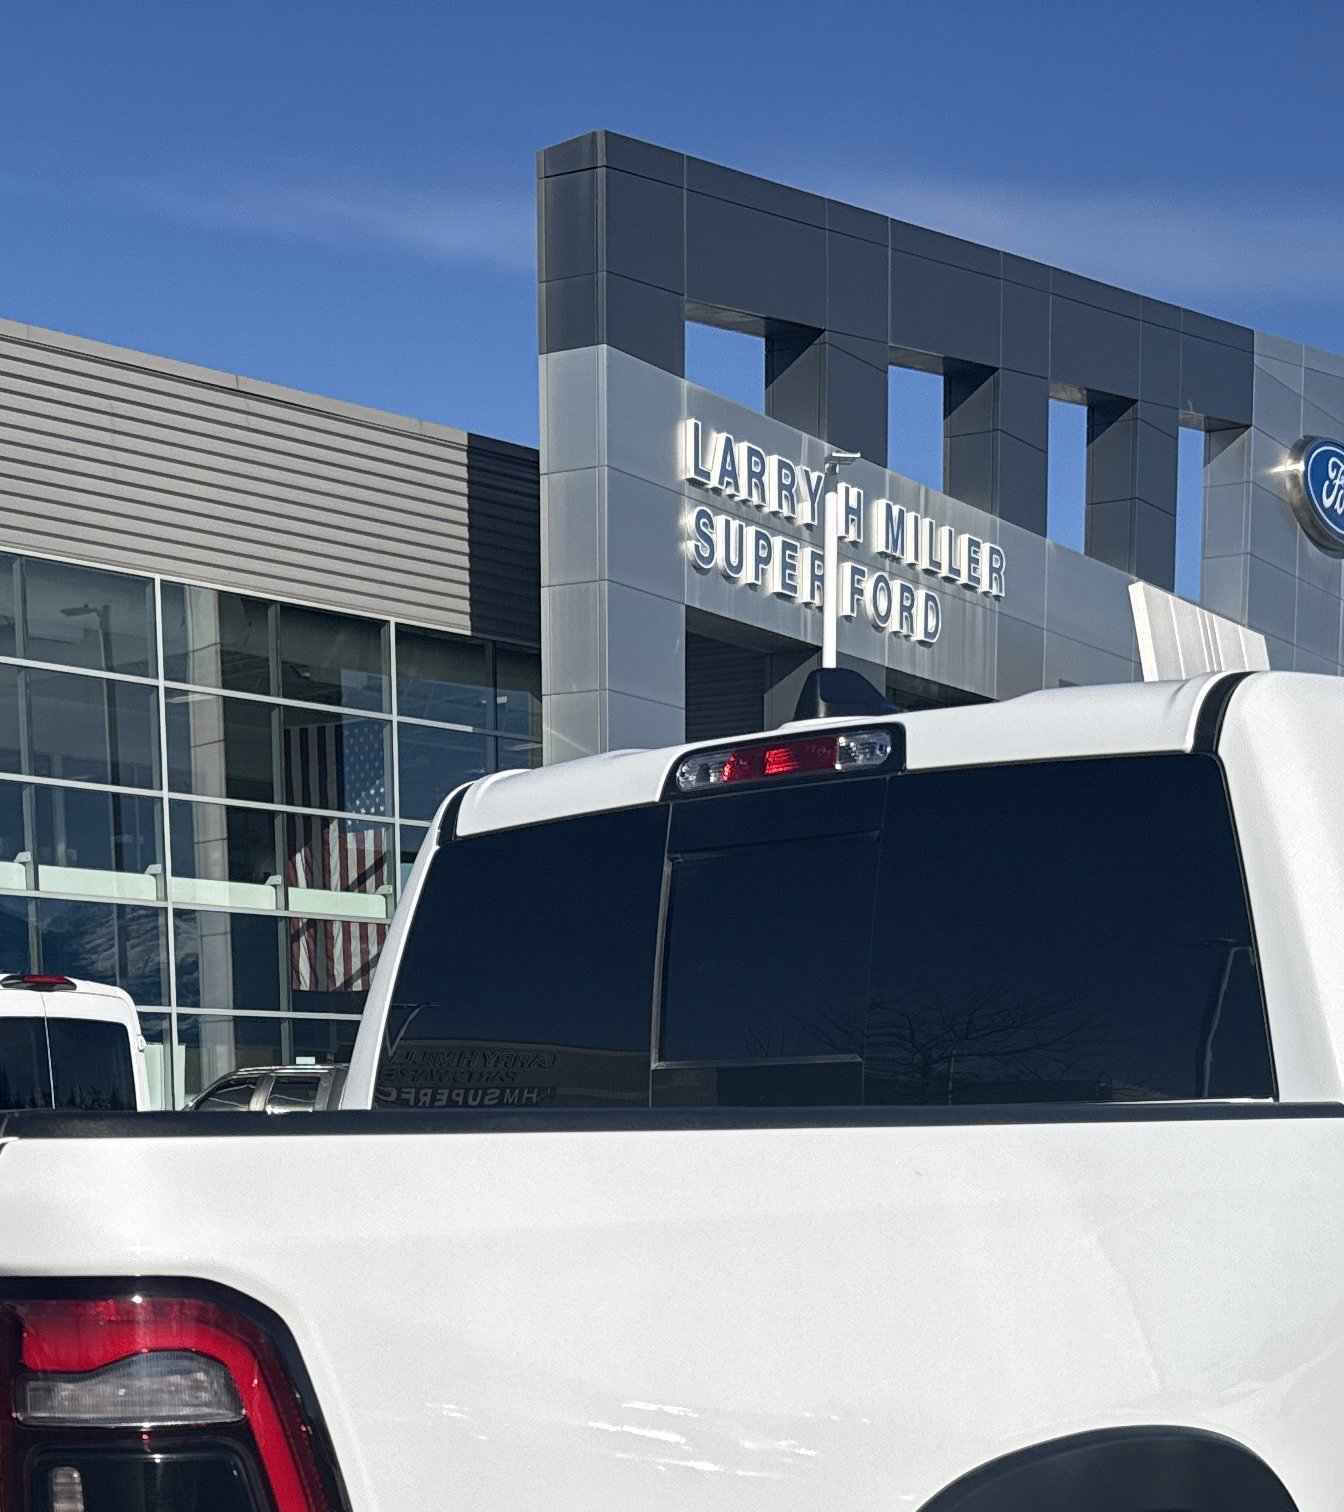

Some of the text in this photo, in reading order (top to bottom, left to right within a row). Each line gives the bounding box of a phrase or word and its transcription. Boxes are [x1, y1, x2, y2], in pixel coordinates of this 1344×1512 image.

[683, 418, 1007, 598] LARRY H MILLER
[685, 506, 942, 644] SUPER FORD
